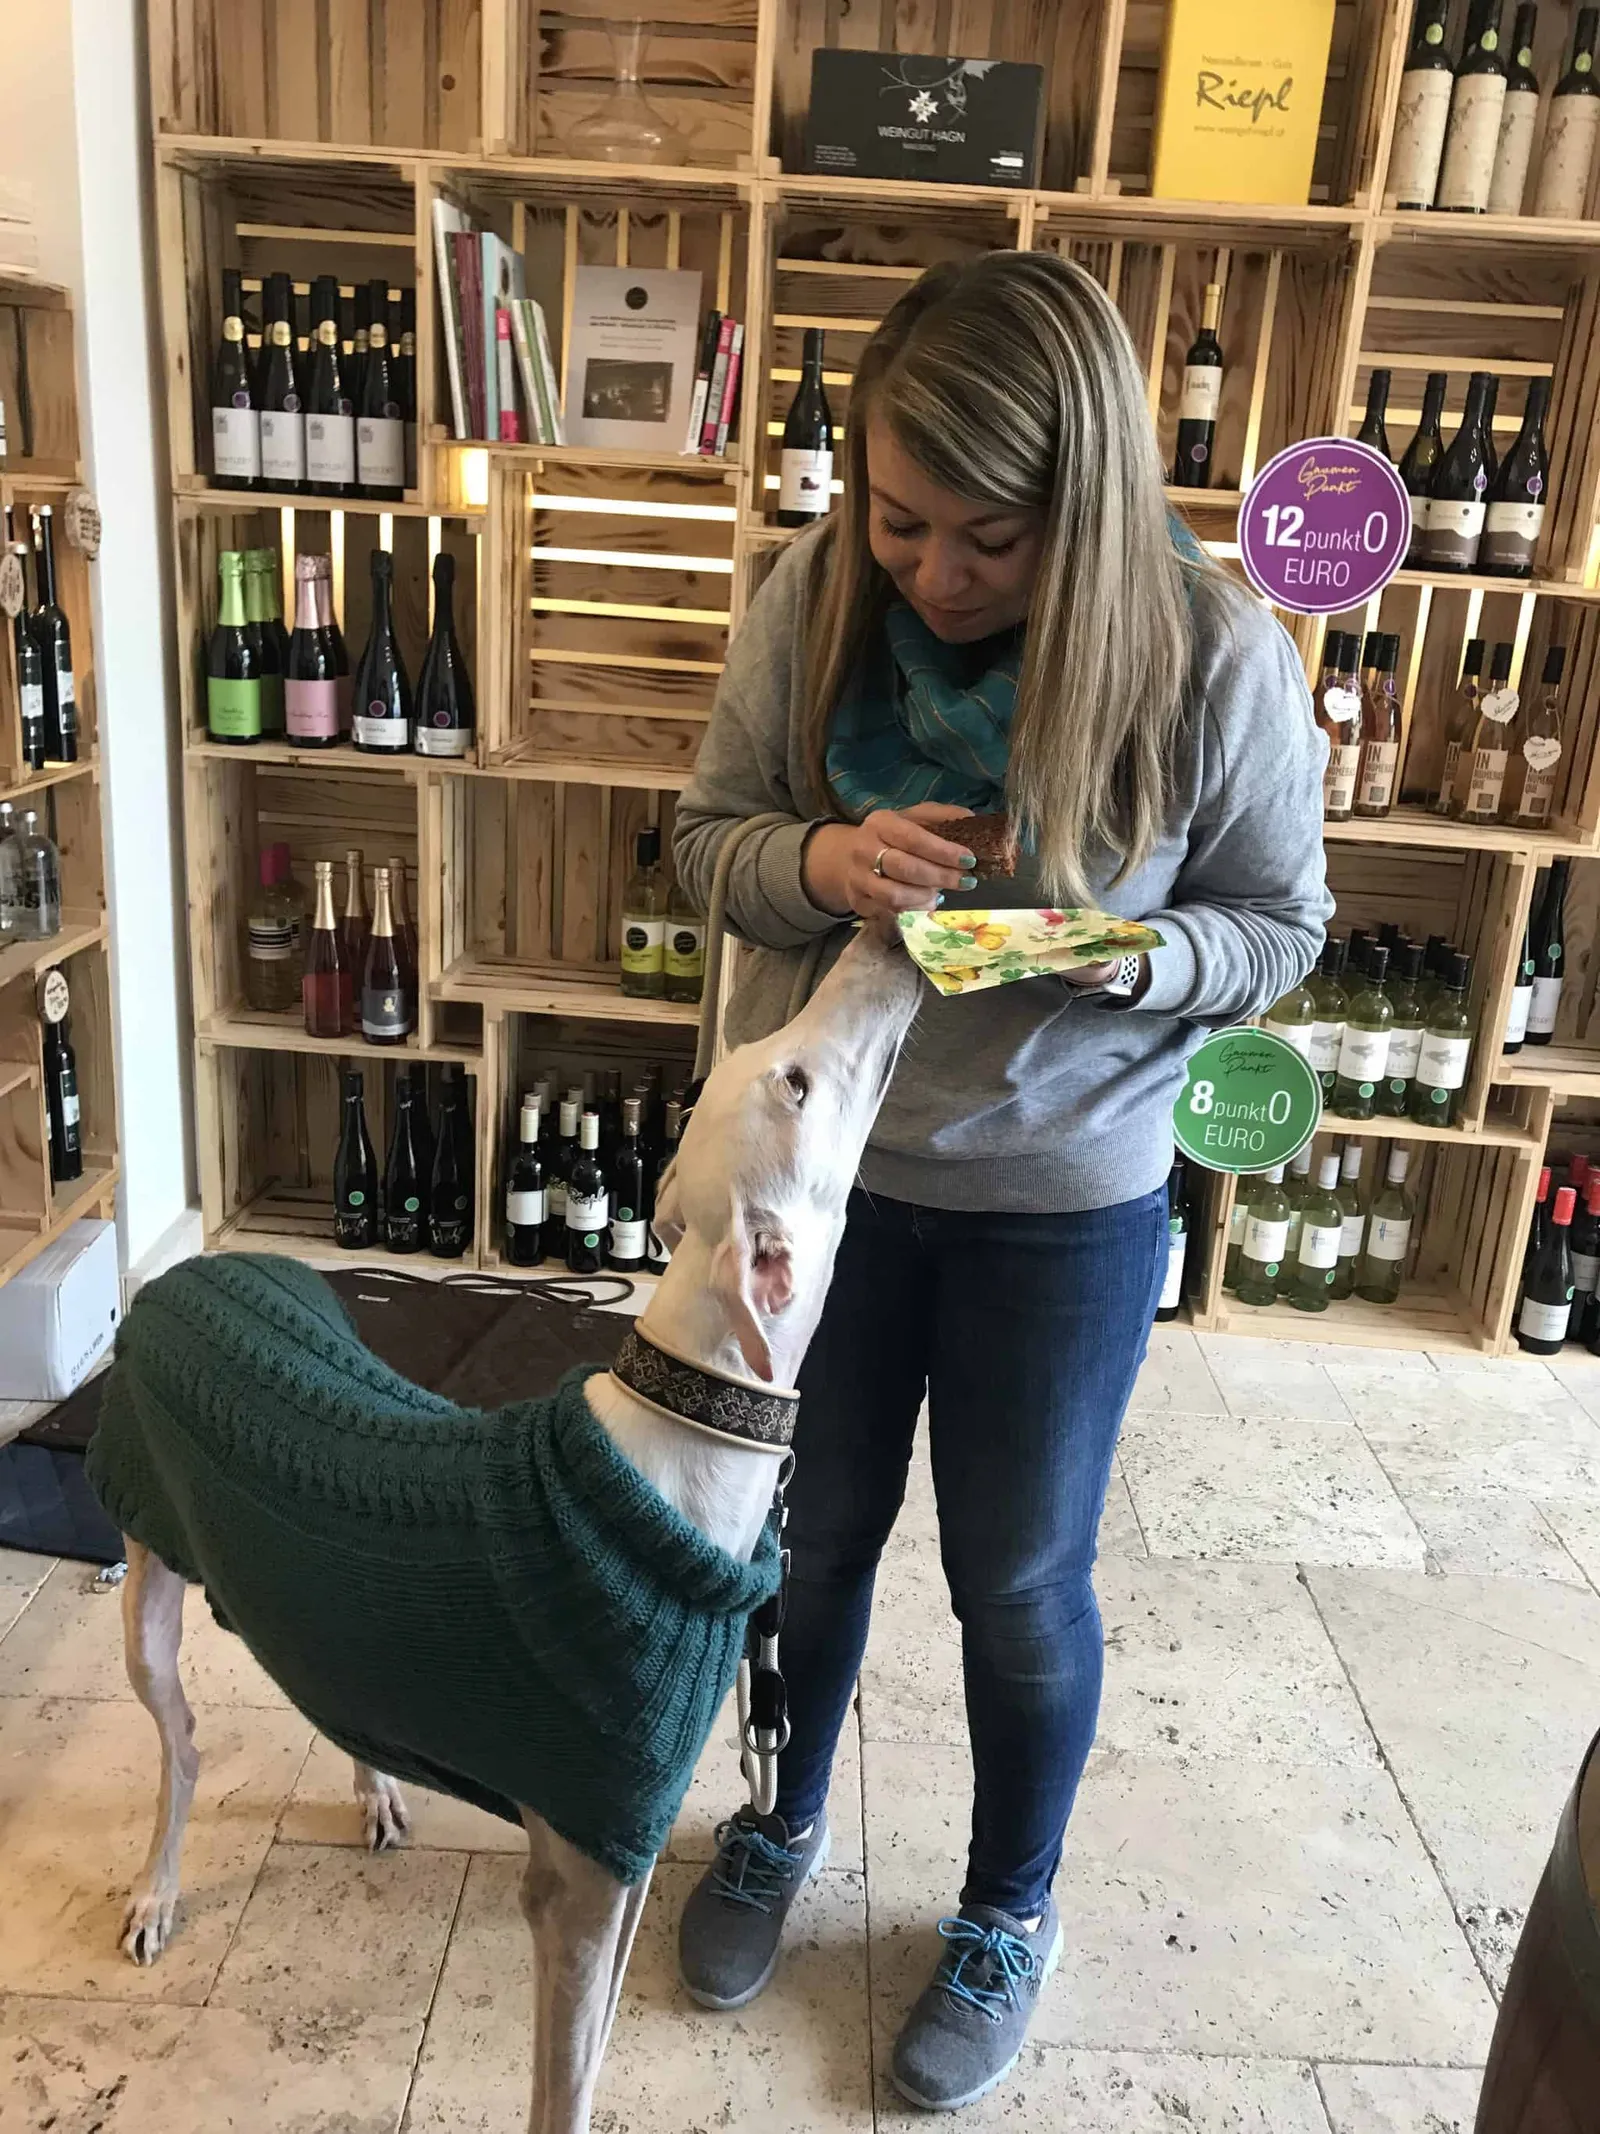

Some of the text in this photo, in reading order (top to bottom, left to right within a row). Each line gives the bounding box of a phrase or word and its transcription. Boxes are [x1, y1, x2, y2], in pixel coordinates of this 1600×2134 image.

[1196, 71, 1293, 124] Riepl
[878, 126, 966, 143] WEINGUT HAGN
[1298, 456, 1360, 484] Gaumen
[1304, 474, 1362, 501] Punkt
[1284, 558, 1350, 587] EURO
[1367, 744, 1382, 762] IN
[1476, 751, 1491, 770] IN
[1204, 1124, 1265, 1151] EURO
